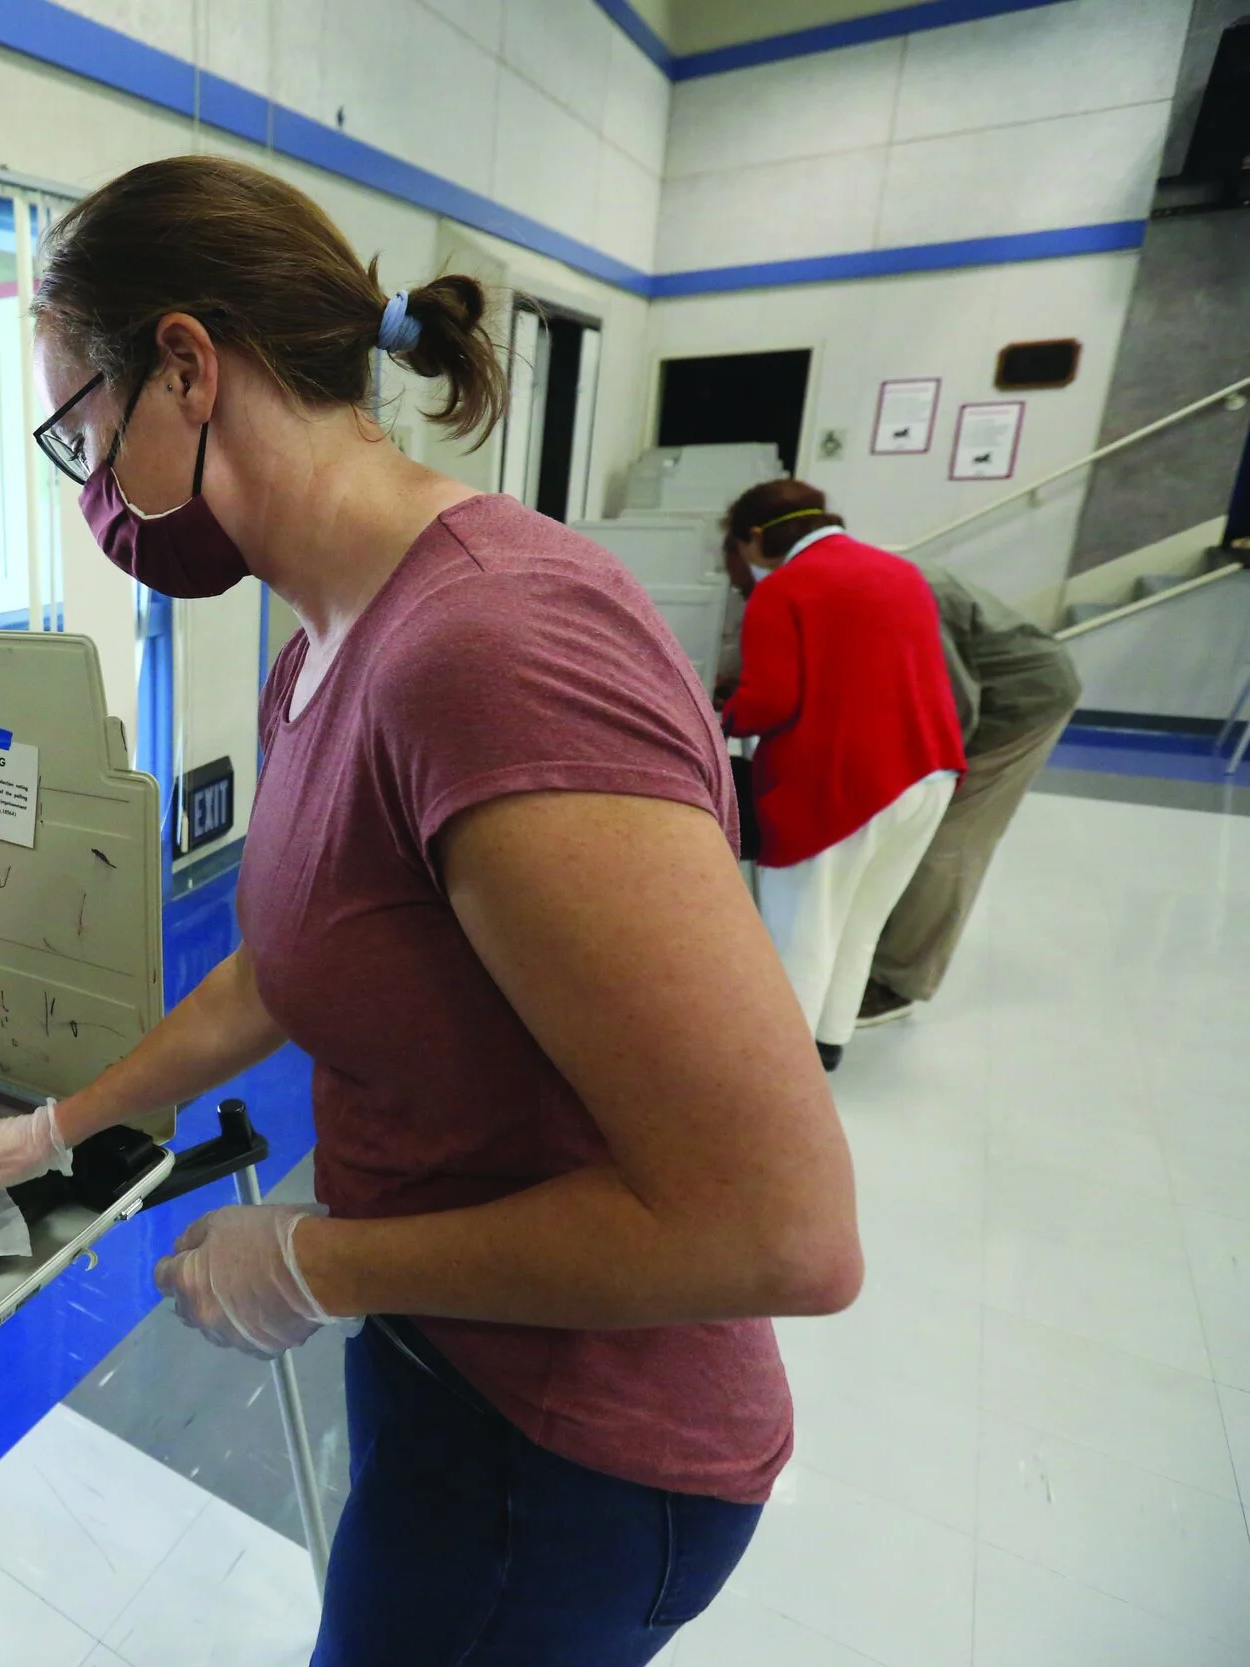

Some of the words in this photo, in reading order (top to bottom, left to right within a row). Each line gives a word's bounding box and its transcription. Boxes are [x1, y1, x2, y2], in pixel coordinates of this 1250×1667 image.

[0, 779, 14, 787] election
[15, 784, 28, 792] voting
[14, 793, 28, 802] polling
[194, 780, 228, 837] EXIT
